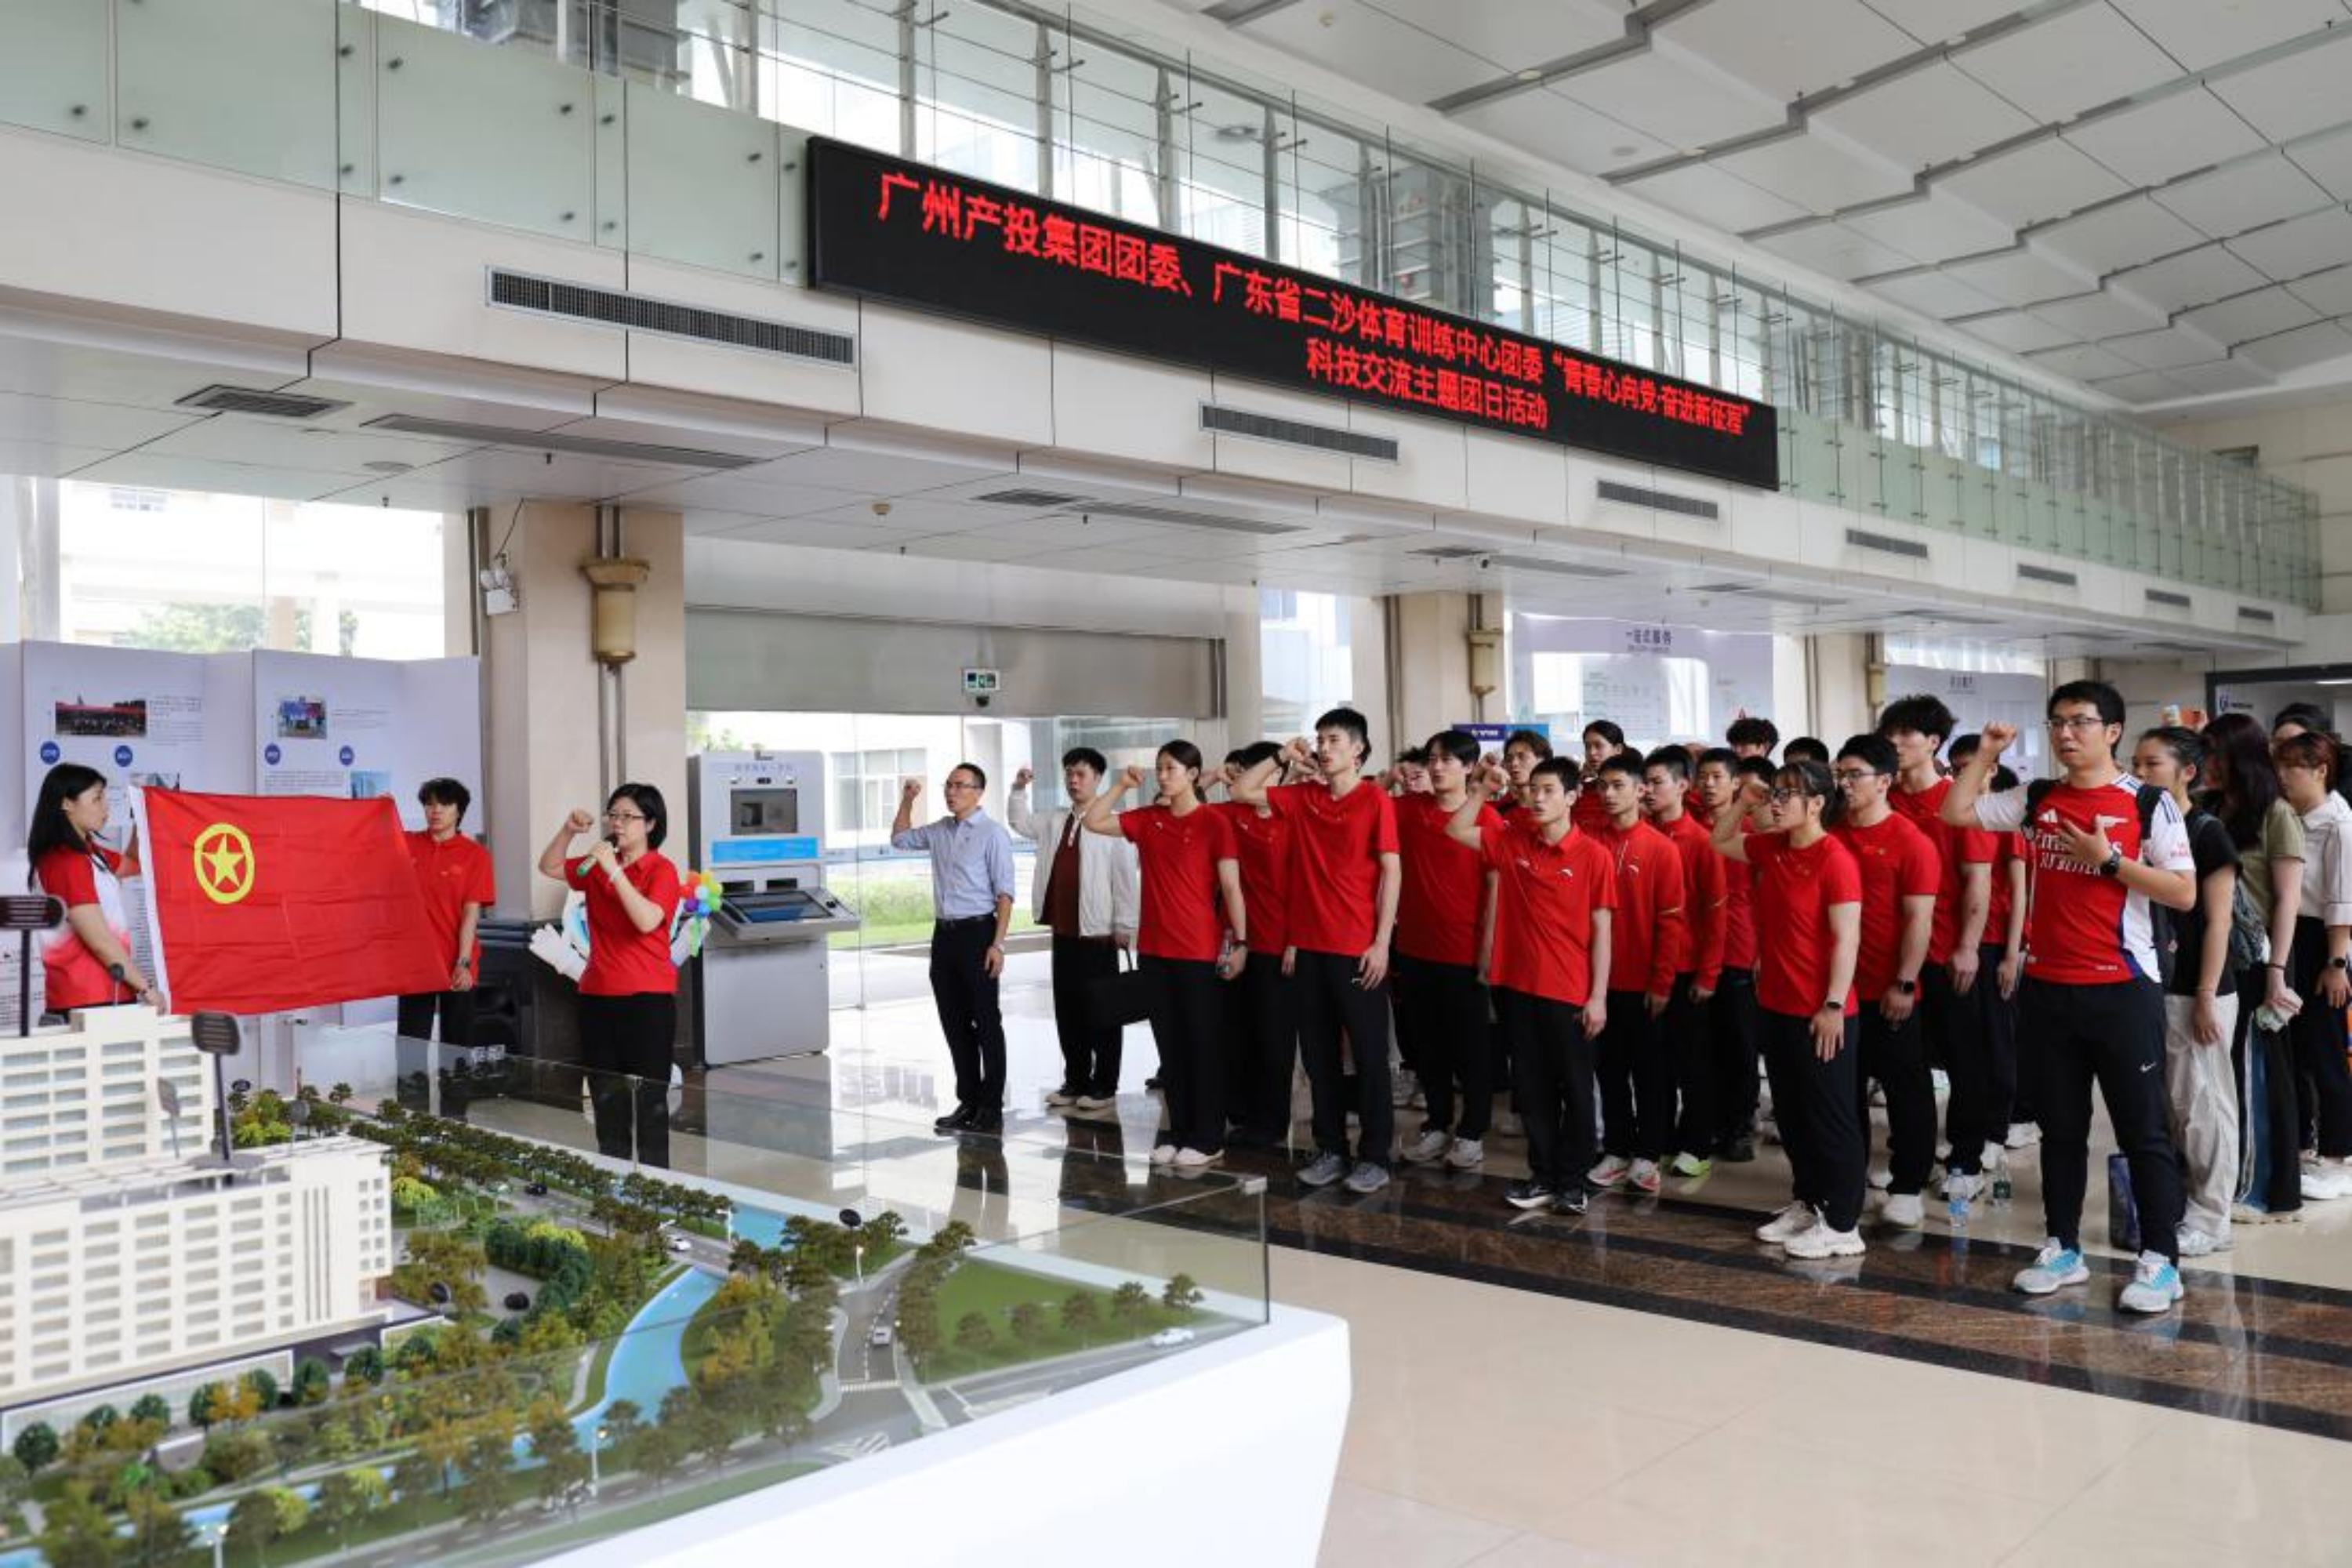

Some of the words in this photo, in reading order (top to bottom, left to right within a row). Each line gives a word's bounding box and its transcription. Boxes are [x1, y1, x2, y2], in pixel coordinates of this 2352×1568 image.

[1305, 336, 1548, 430] 科技交流主题团日活动
